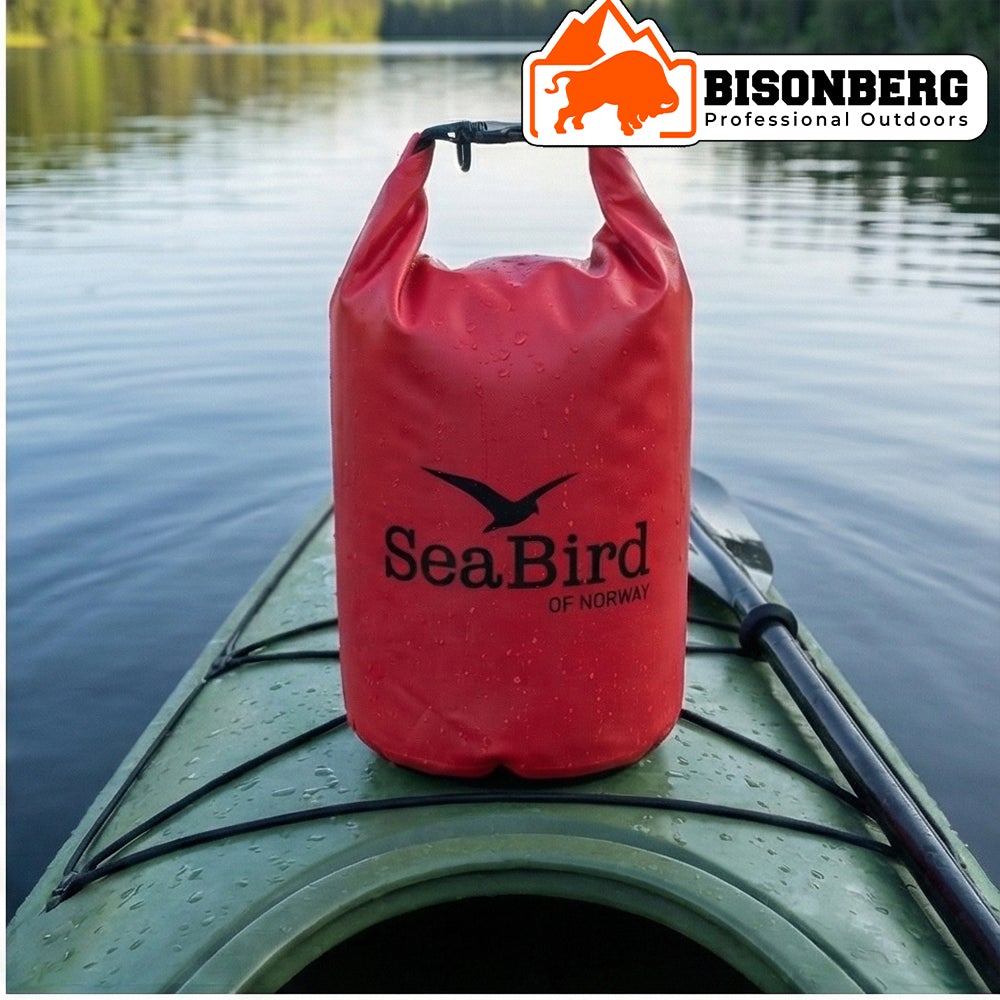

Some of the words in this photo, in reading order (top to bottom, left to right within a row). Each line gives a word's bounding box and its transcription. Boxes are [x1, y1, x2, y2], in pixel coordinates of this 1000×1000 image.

[385, 520, 650, 589] SeaBird
[549, 596, 573, 613] OF
[580, 584, 650, 610] NORWAY
